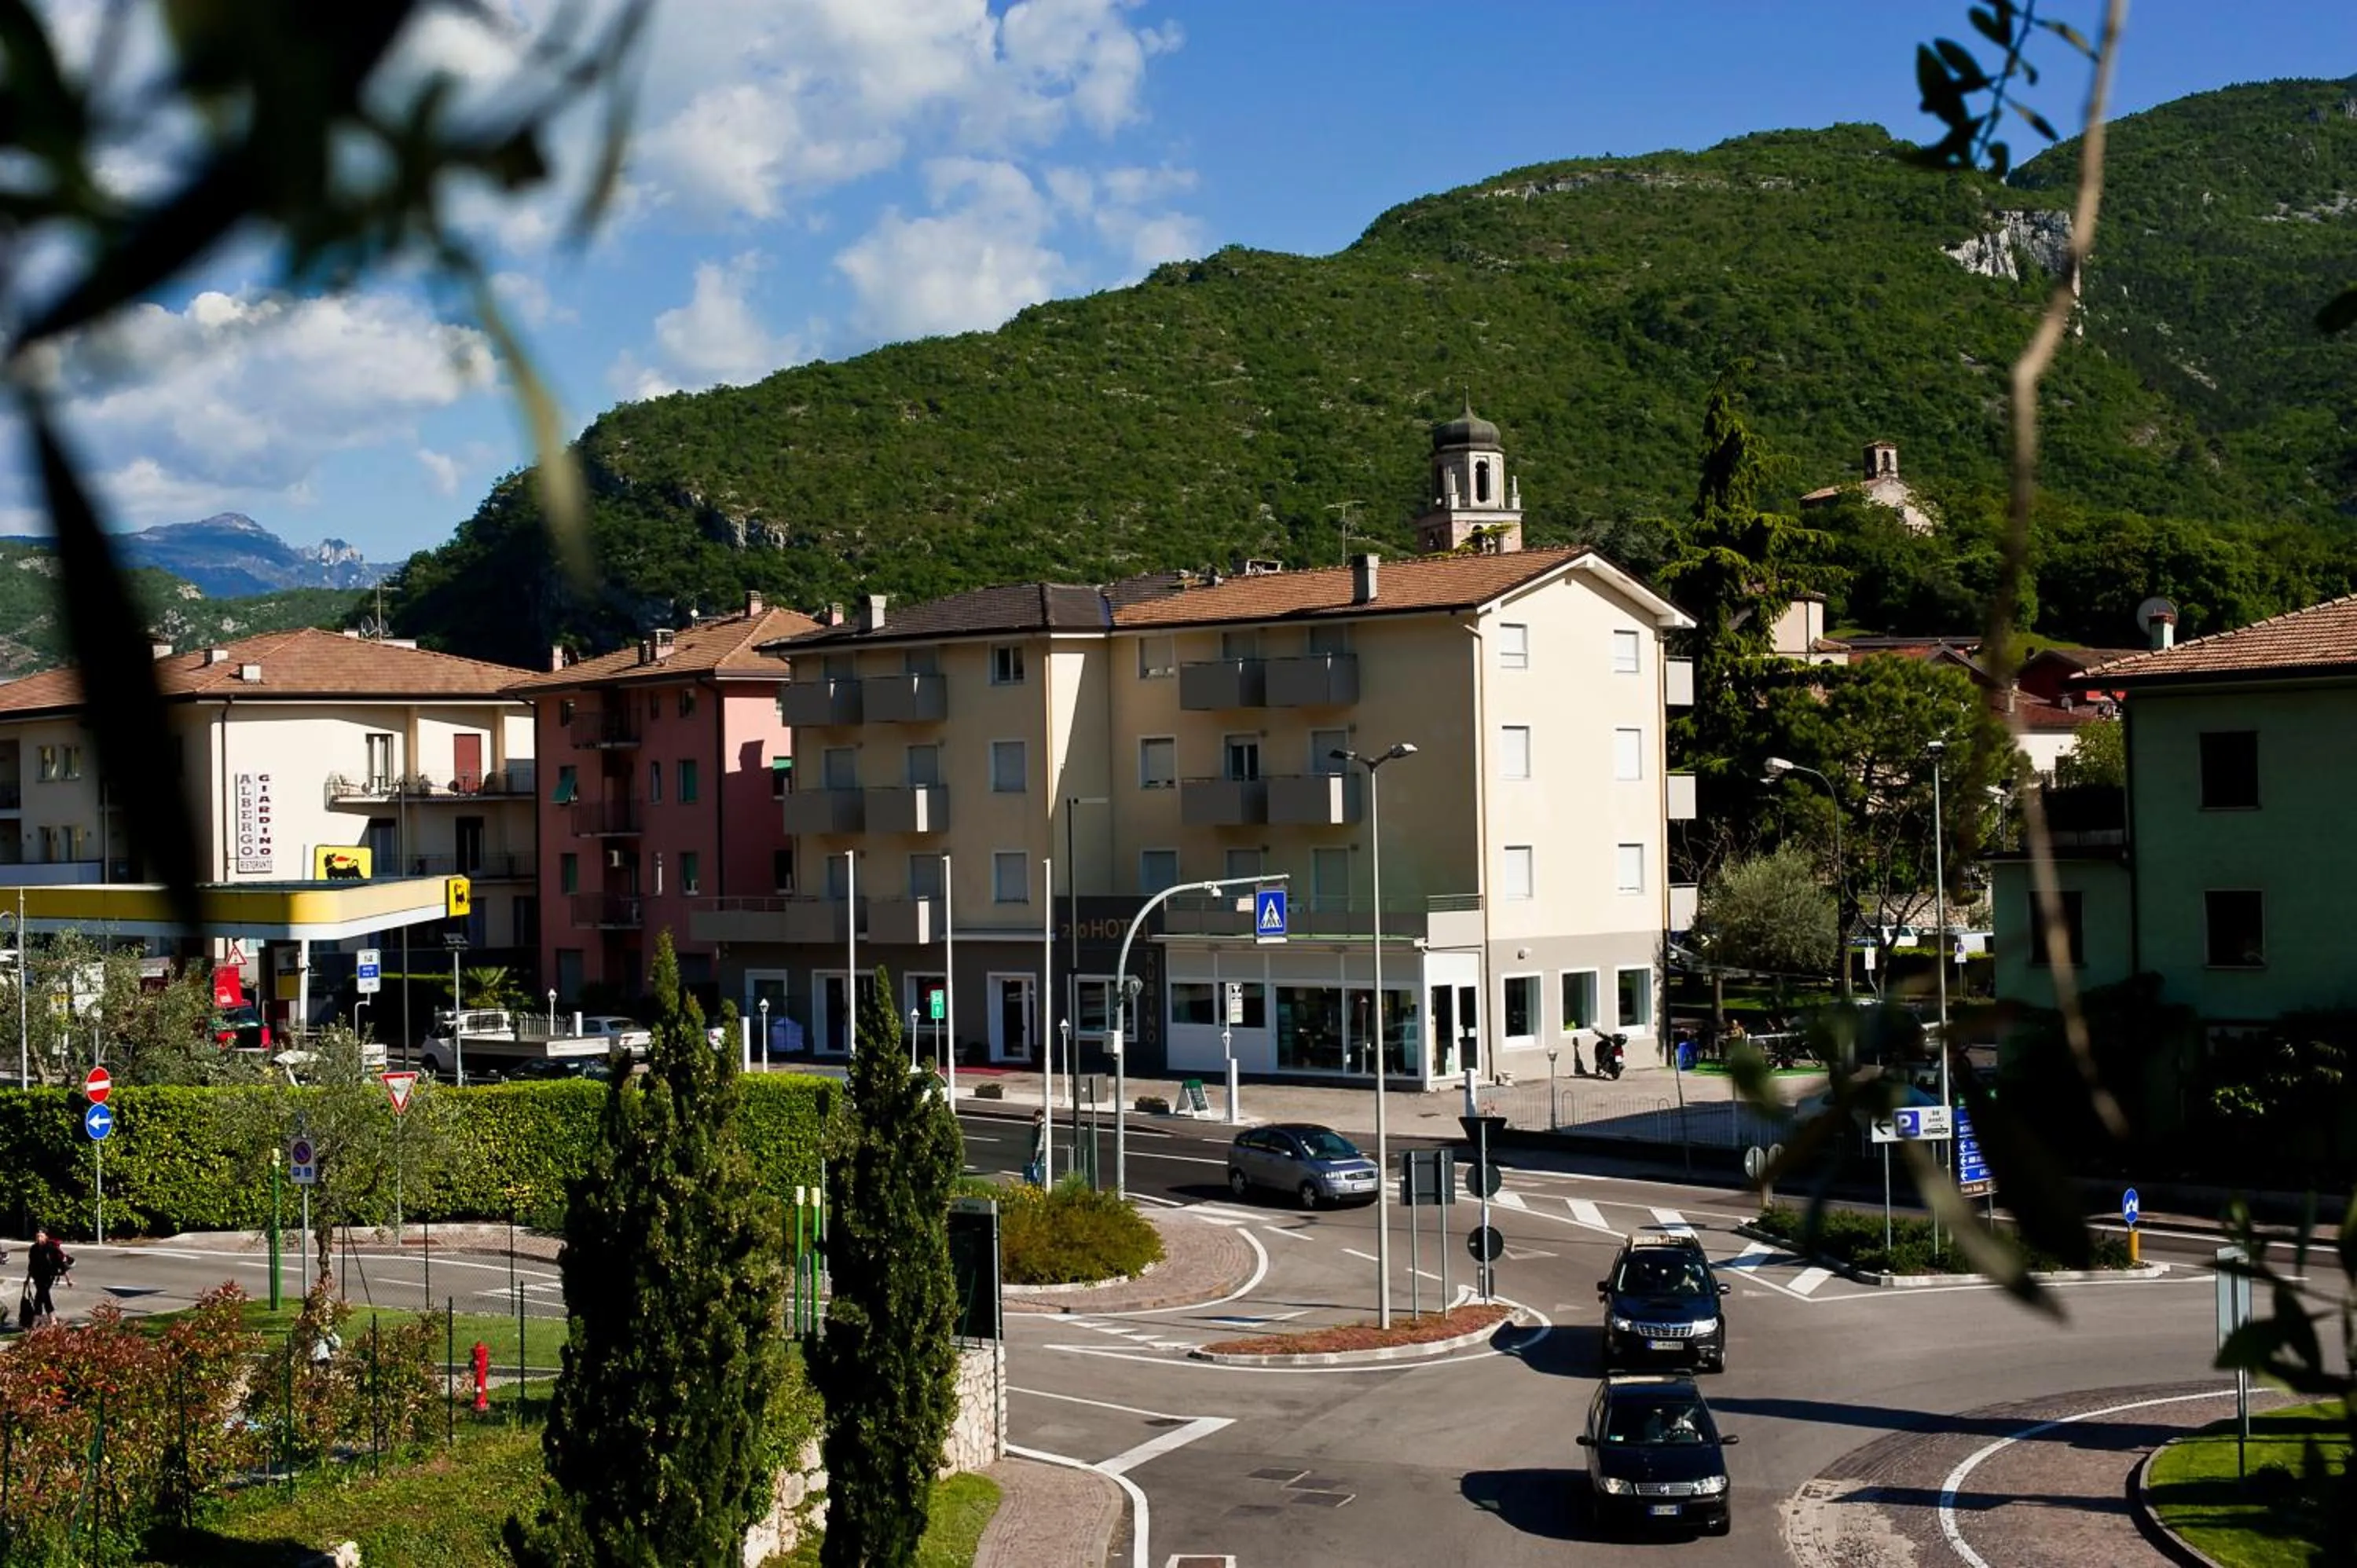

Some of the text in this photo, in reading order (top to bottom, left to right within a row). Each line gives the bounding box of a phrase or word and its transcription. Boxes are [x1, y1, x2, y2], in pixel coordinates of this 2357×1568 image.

[240, 774, 253, 855] ALBERGO
[258, 774, 271, 855] GIARDINO
[1061, 923, 1088, 939] 20
[1146, 951, 1156, 1044] RUBINO
[1897, 1114, 1912, 1134] P
